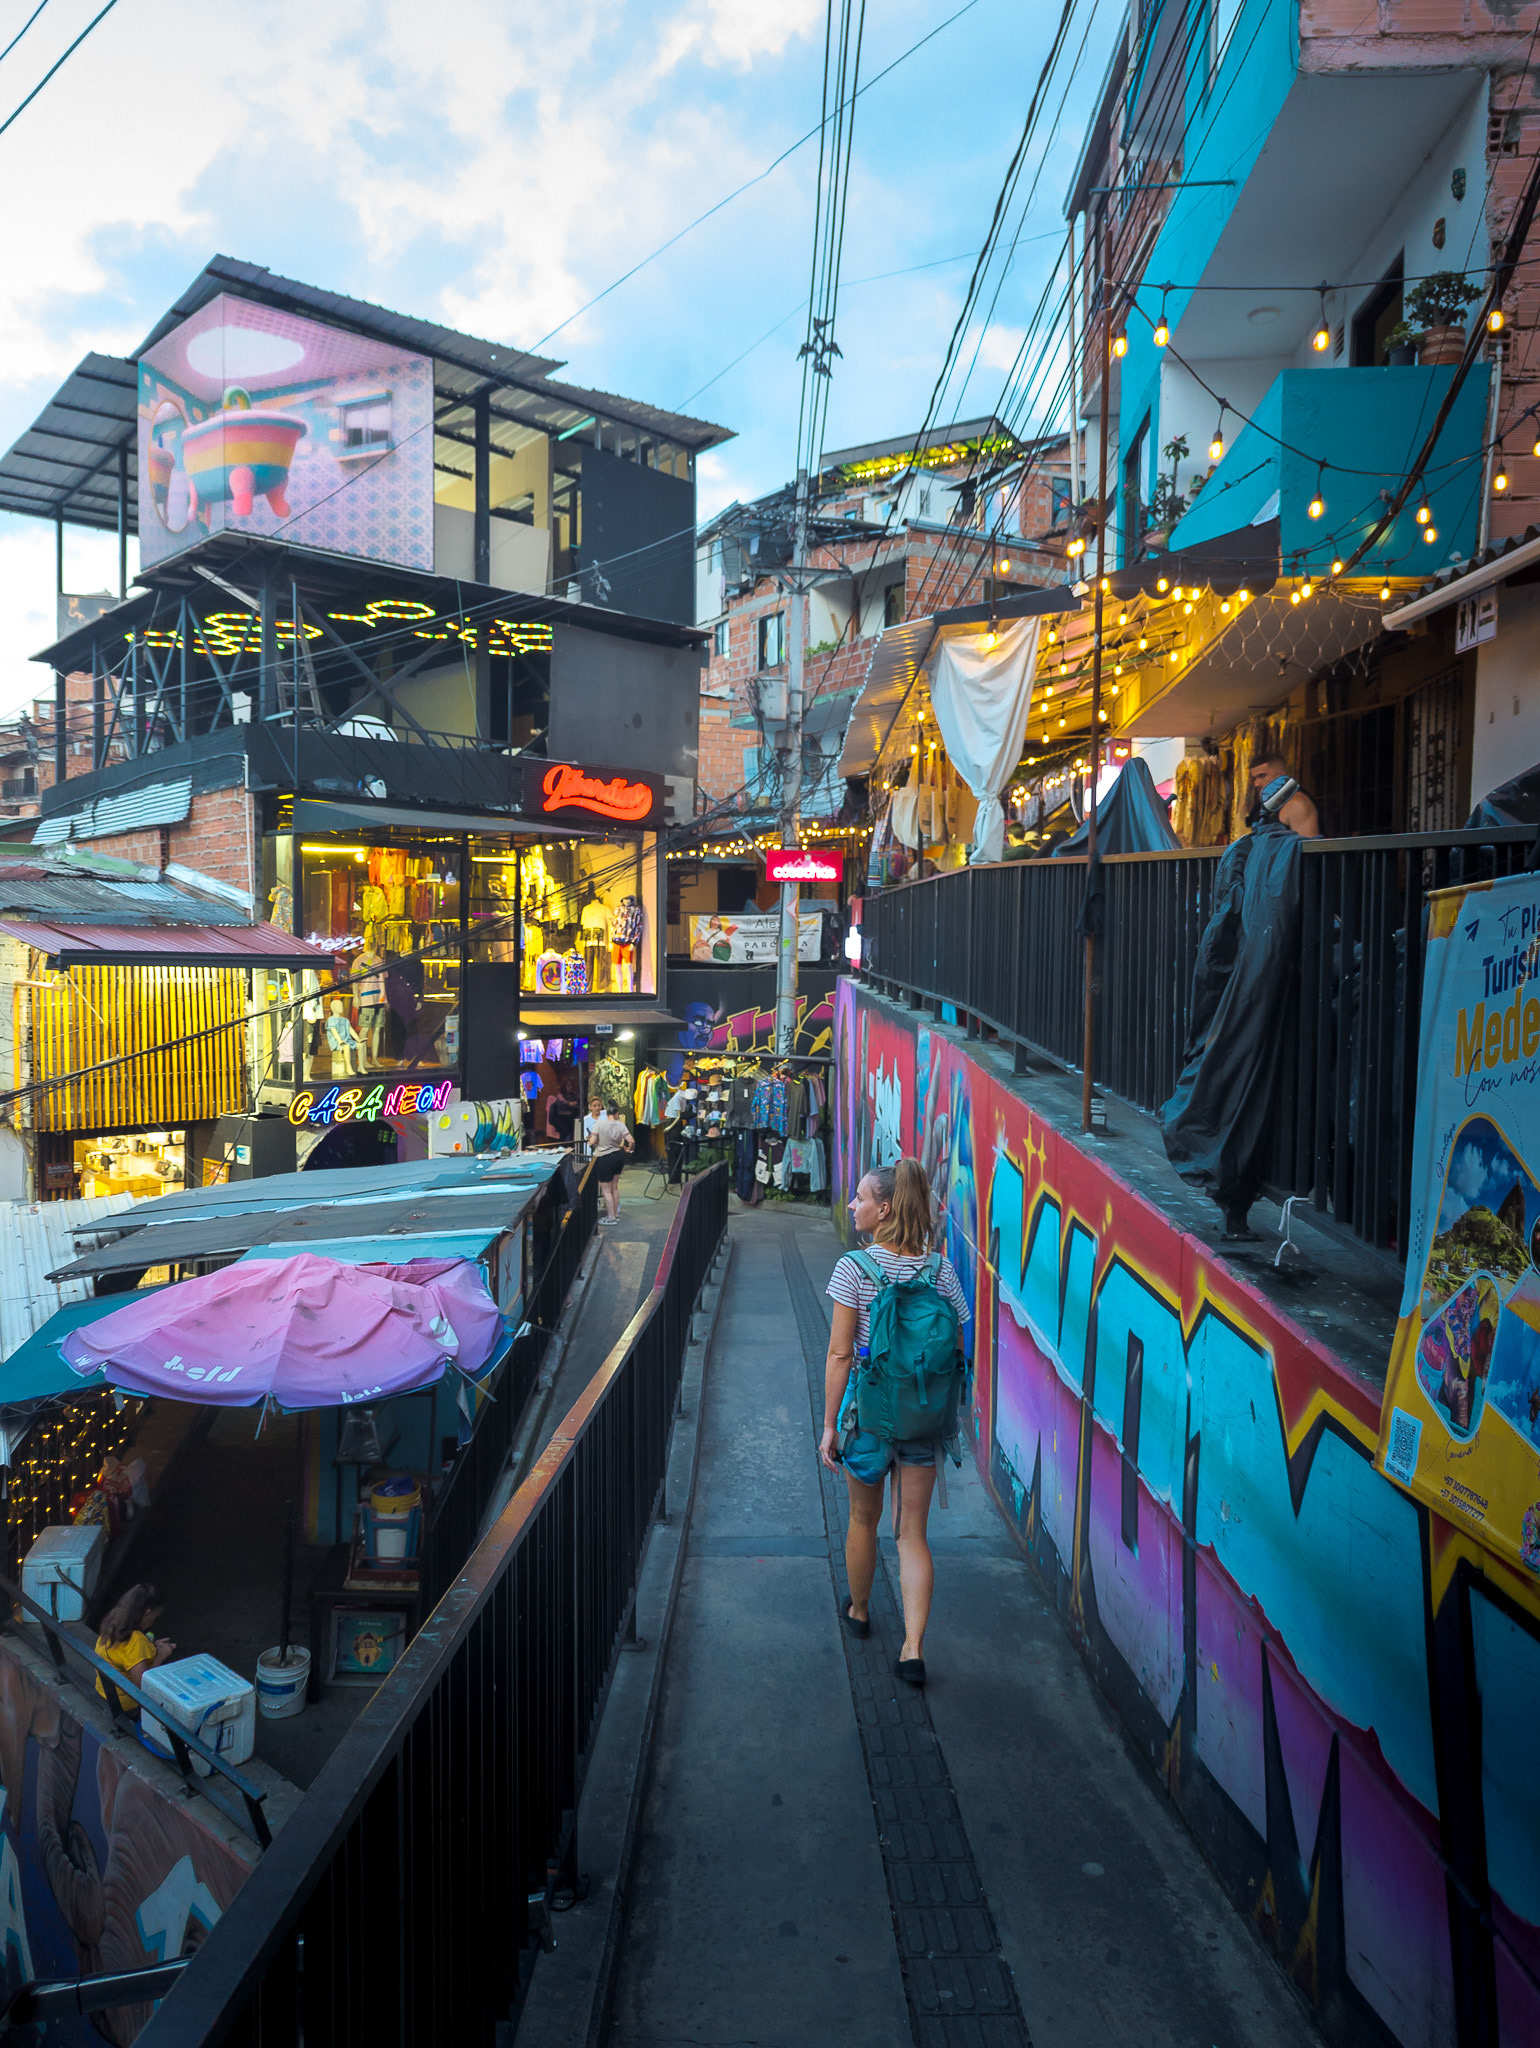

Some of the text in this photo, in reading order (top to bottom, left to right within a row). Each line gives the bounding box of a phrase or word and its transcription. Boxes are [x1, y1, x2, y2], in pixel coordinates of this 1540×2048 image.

[1498, 905, 1520, 946] Tu
[287, 1079, 453, 1126] CASA NEON
[163, 1354, 244, 1383] bold
[340, 1385, 383, 1404] bold
